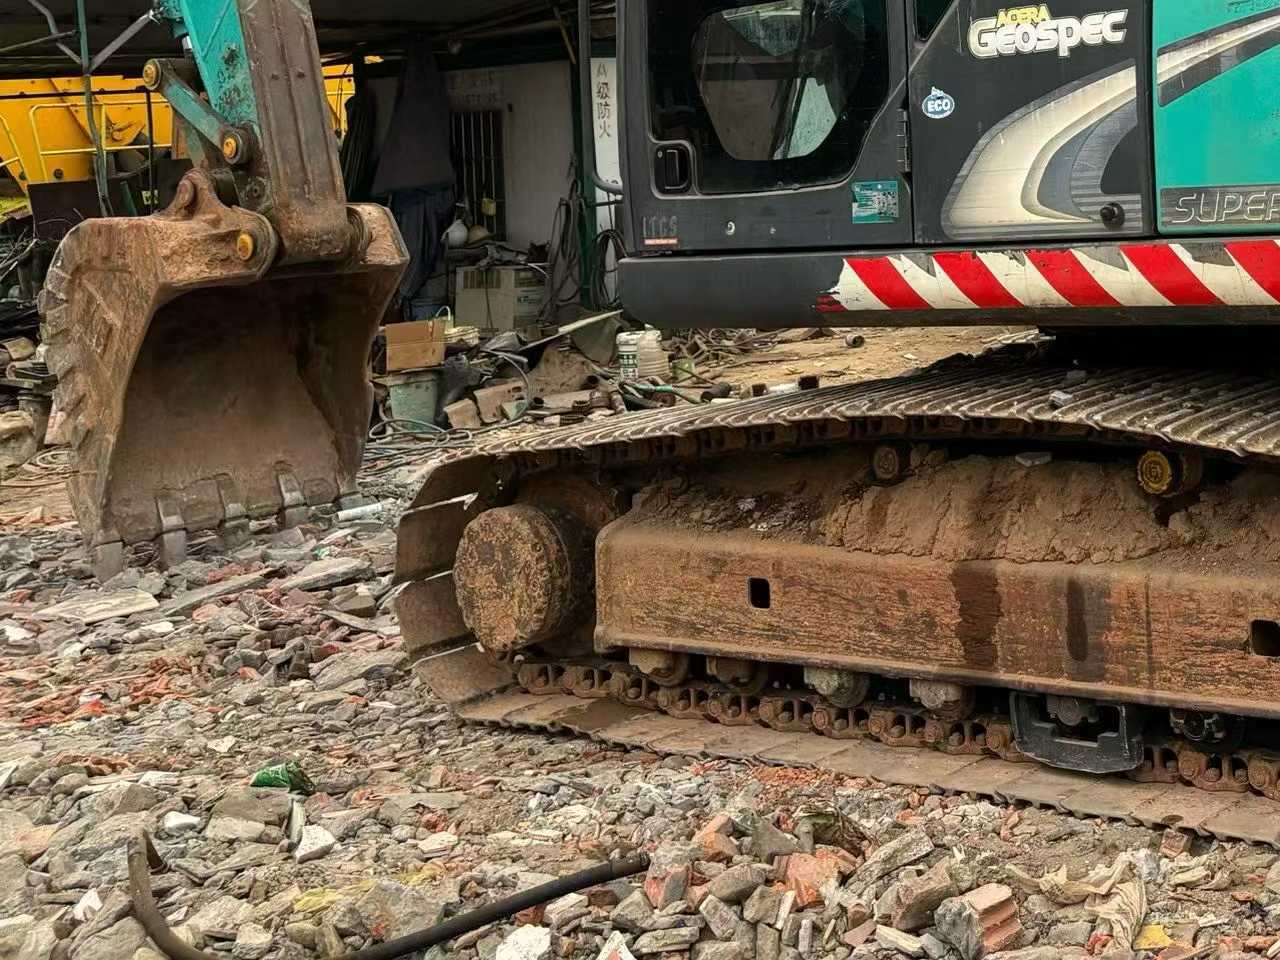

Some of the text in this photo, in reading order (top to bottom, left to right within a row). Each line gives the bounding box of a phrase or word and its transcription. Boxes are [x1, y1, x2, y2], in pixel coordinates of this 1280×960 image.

[596, 62, 612, 139] A级防火
[927, 98, 951, 112] ECO
